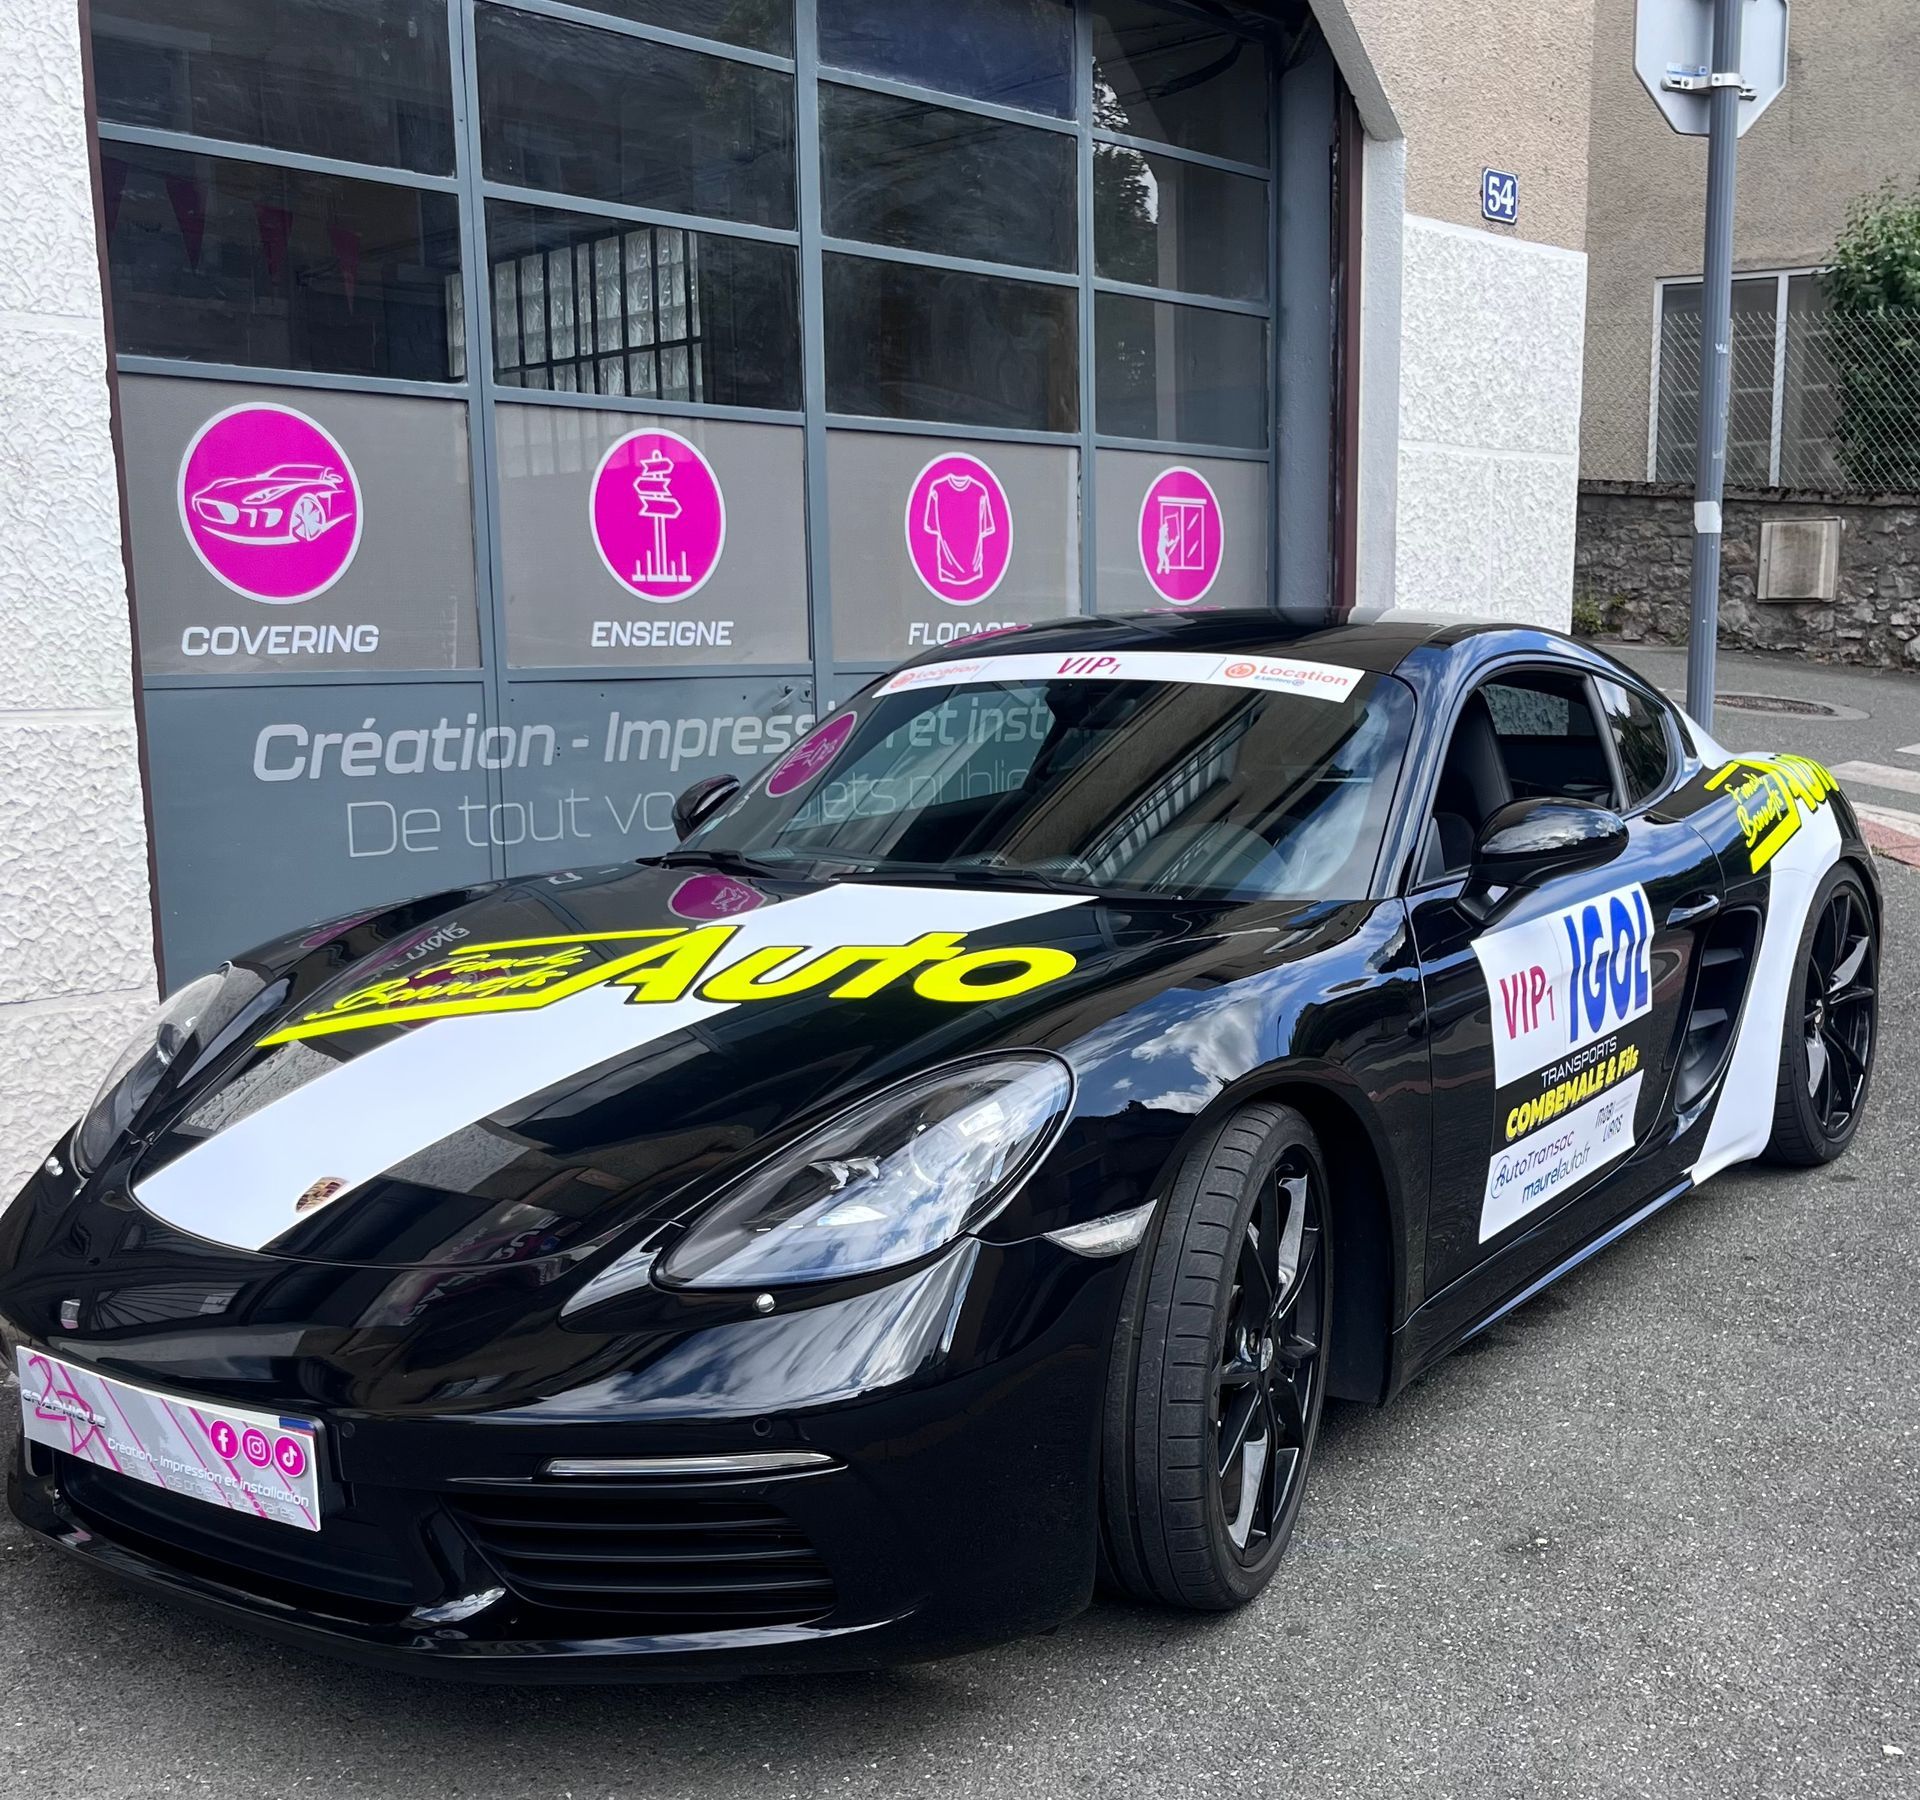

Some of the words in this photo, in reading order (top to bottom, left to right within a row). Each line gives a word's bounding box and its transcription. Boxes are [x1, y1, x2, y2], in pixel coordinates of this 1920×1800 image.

[1488, 175, 1515, 215] 54
[181, 623, 380, 656] COVERING
[590, 620, 734, 648] ENSEIGNE
[1260, 665, 1349, 686] Location
[253, 713, 556, 782] Création
[572, 735, 589, 748] -
[908, 699, 958, 747] et
[966, 697, 1054, 744] inst
[347, 800, 441, 858] De
[458, 788, 592, 845] tout
[604, 792, 676, 834] vo
[600, 925, 1077, 1002] Auto
[1563, 890, 1649, 1044] IGOL
[1541, 1035, 1617, 1088] TRANSPORTS
[1505, 1061, 1607, 1142] COMBEMALE
[1605, 1055, 1617, 1087] &
[1617, 1043, 1640, 1082] Fils
[22, 1388, 106, 1428] GRAPHIQUE
[107, 1436, 152, 1463] Création
[160, 1455, 223, 1485] Impression
[224, 1478, 238, 1488] et
[239, 1477, 309, 1507] installation
